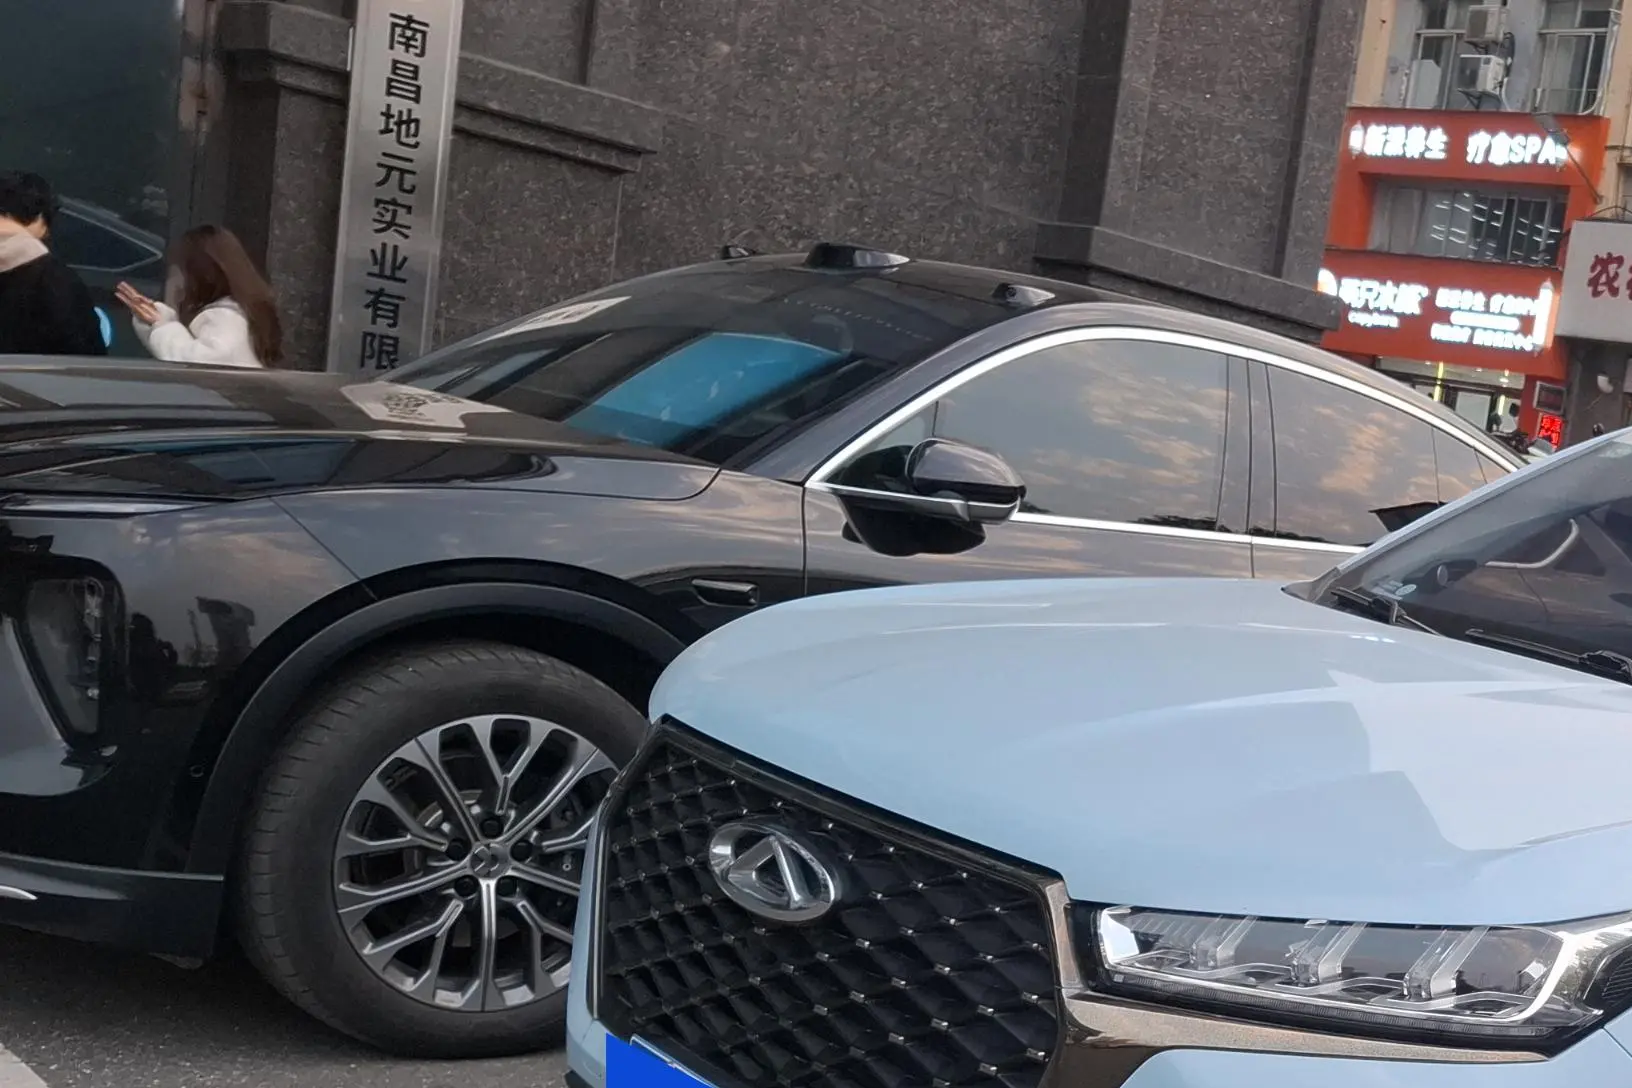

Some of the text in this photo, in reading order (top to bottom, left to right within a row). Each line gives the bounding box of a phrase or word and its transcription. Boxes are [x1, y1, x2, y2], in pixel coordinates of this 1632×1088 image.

[360, 13, 430, 371] 南昌地元实业有限
